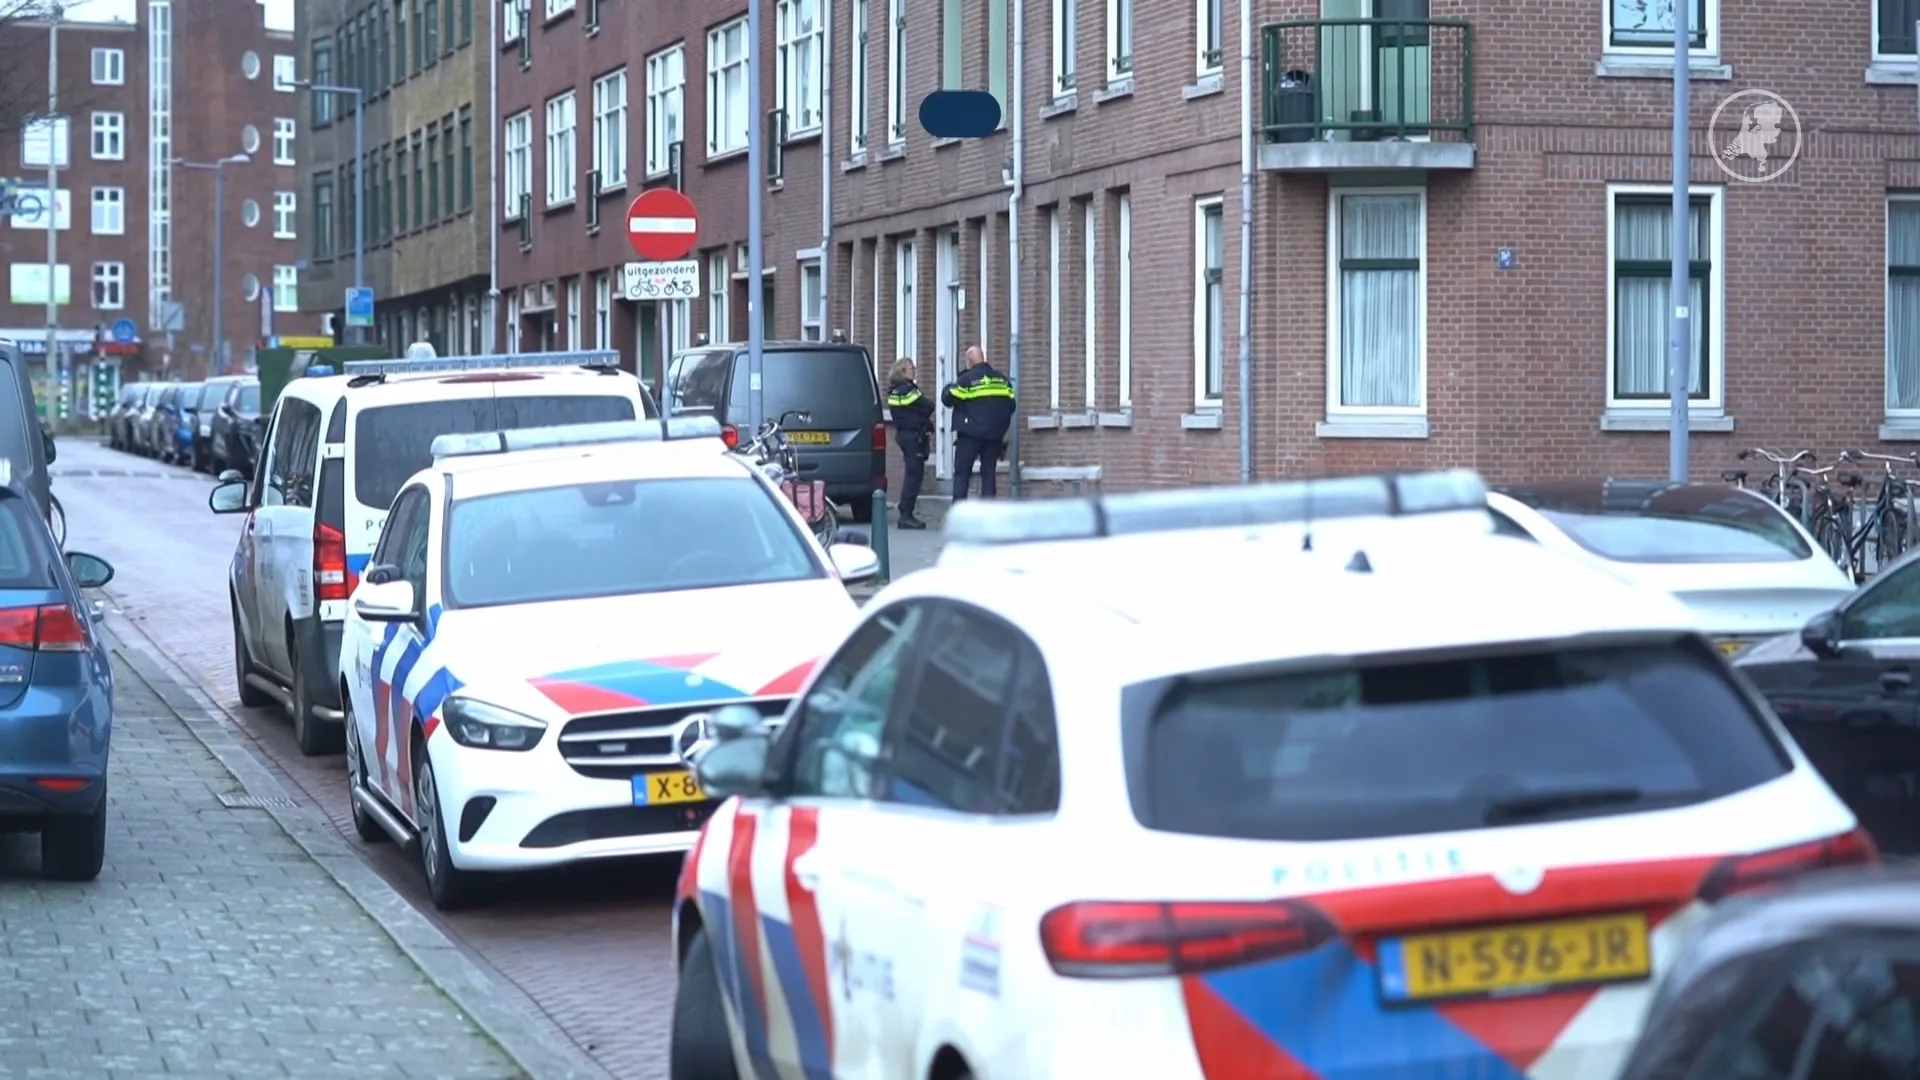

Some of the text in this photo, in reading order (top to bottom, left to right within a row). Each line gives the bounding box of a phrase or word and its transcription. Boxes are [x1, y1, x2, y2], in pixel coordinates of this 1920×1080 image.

[627, 265, 696, 277] uitgezonderd
[1272, 848, 1463, 884] POLITIE
[1421, 923, 1635, 985] N-596-JR
